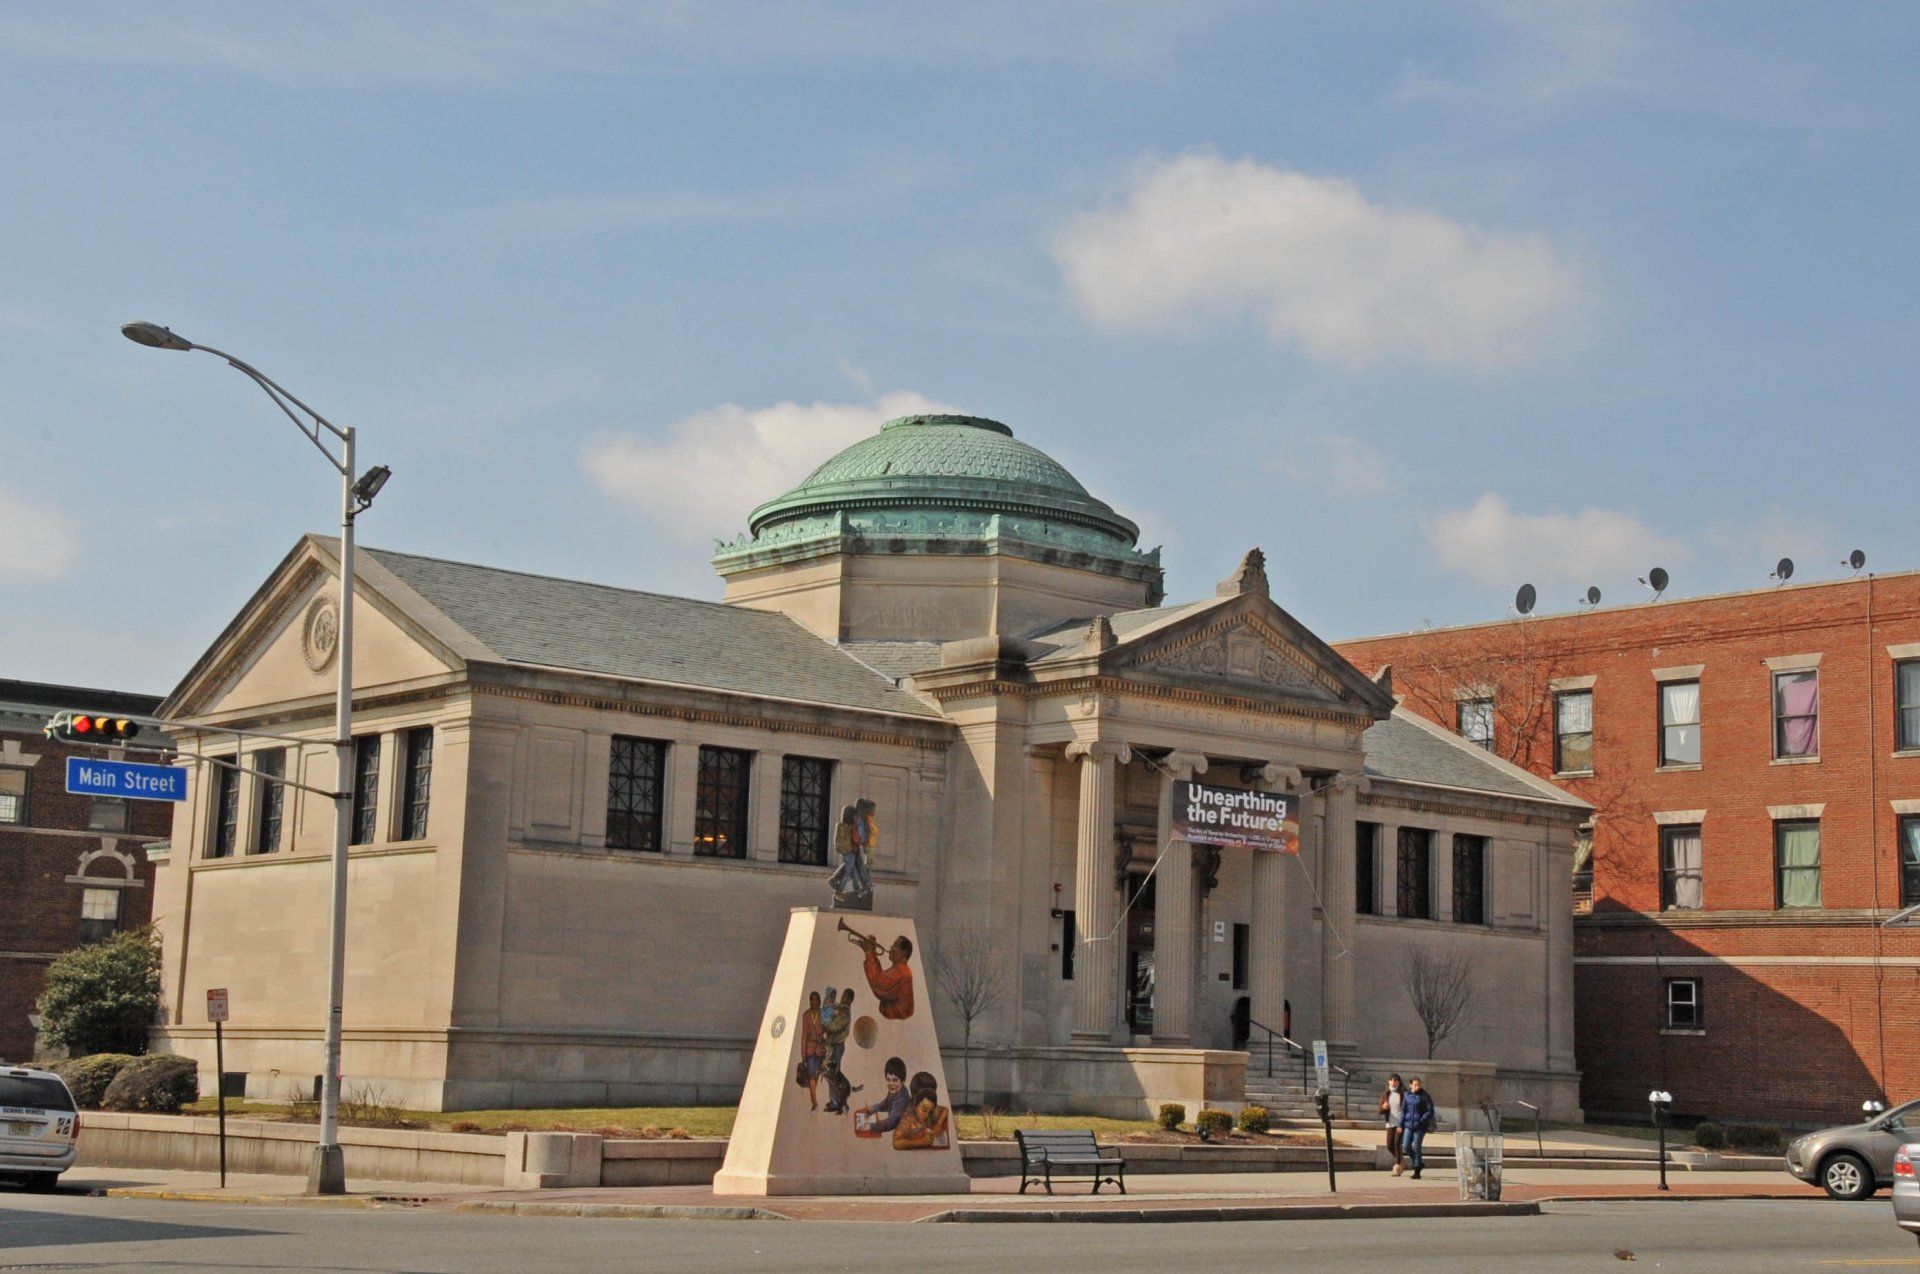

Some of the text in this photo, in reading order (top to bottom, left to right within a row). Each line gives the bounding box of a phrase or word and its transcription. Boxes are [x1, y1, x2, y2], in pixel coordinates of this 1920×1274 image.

[79, 766, 176, 793] Main Street
[1188, 784, 1287, 818] Unearthing
[1187, 803, 1284, 832] the Future:
